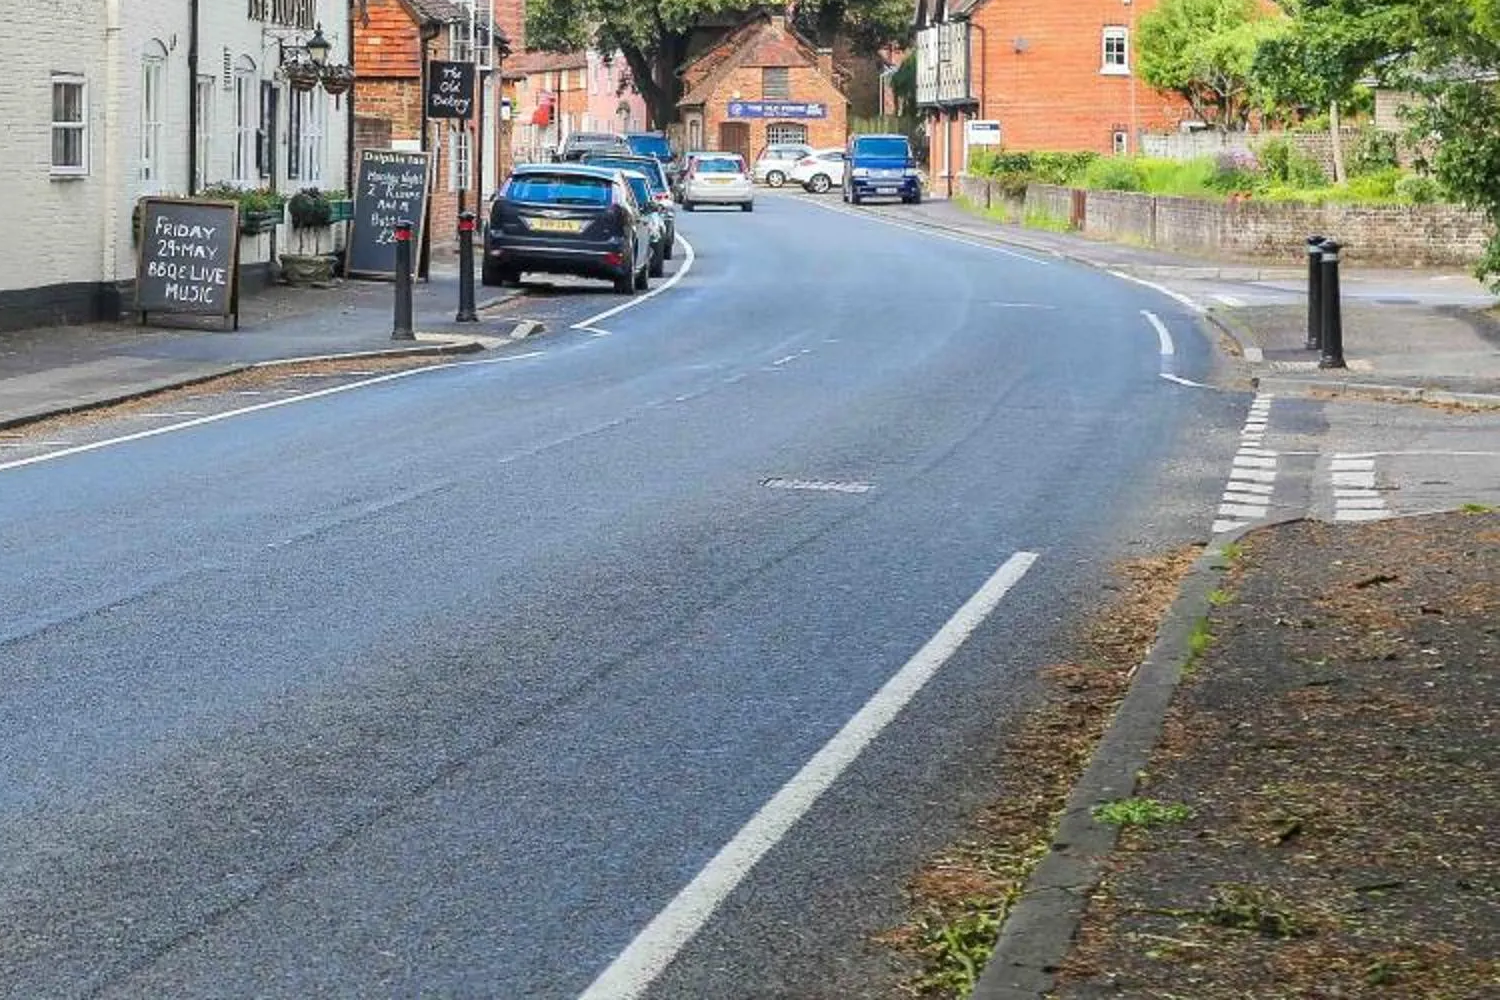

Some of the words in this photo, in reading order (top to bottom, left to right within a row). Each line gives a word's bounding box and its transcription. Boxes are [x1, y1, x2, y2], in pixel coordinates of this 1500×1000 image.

[440, 79, 461, 92] Old
[364, 151, 404, 165] Dolphin
[189, 264, 226, 285] LIVE
[165, 282, 213, 304] MUSIC
